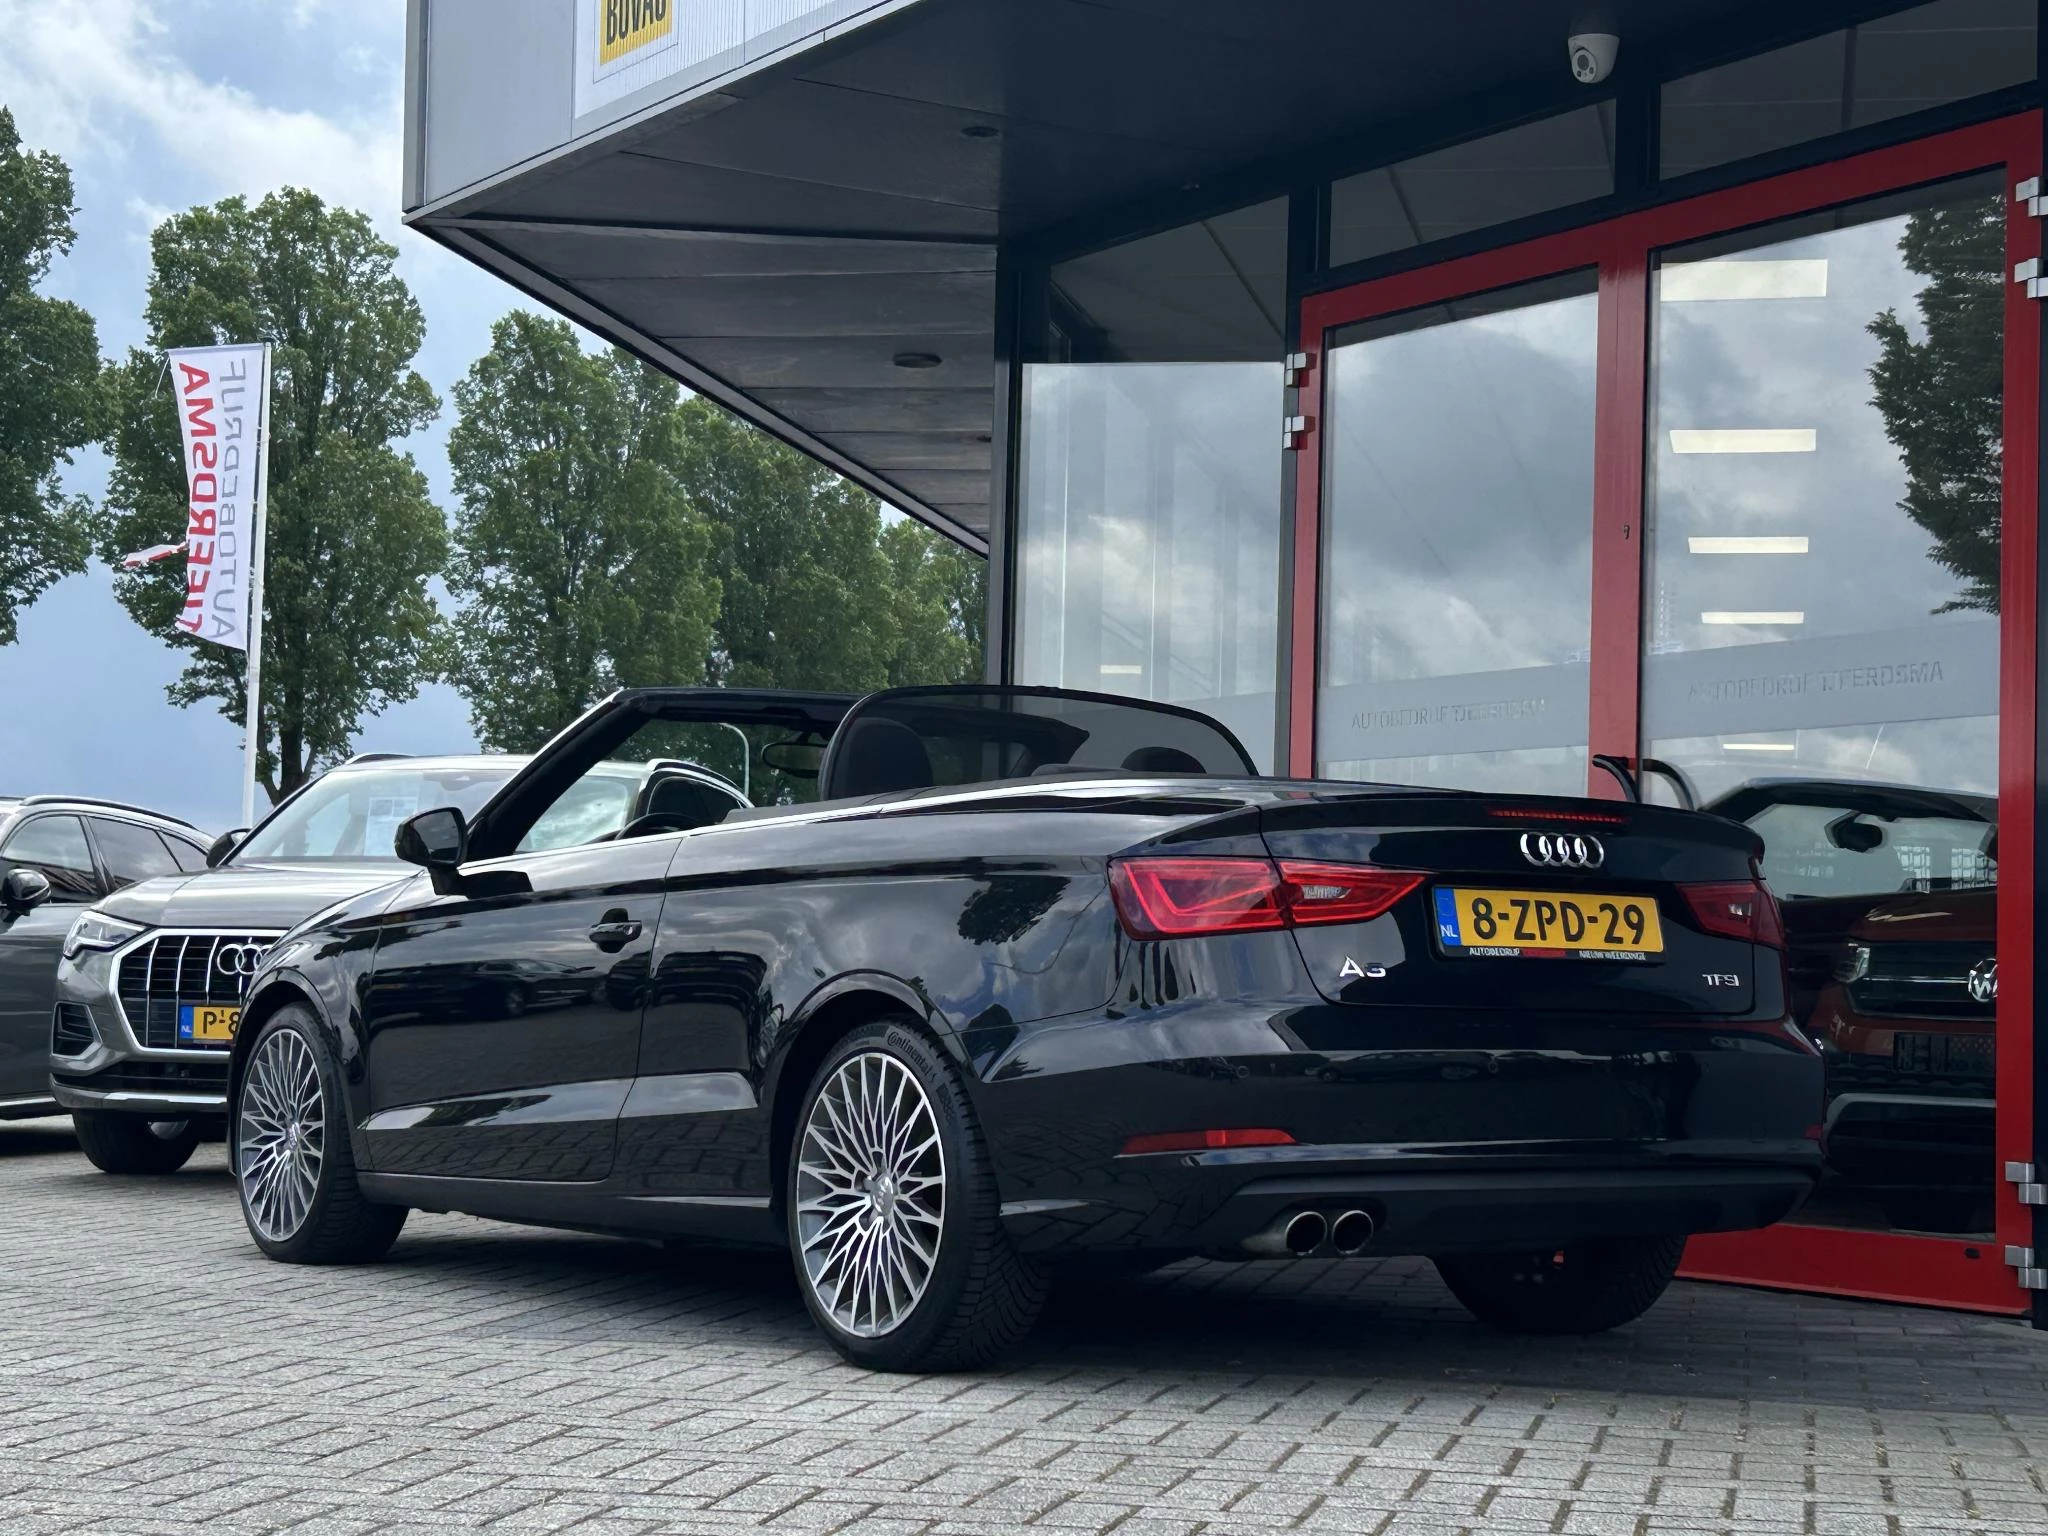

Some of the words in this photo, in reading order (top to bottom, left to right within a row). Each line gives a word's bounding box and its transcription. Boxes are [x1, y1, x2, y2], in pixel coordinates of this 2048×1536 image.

[1471, 897, 1645, 945] 8-ZPD-29
[1440, 924, 1458, 938] NL
[1702, 973, 1740, 987] TFSI
[180, 1024, 193, 1033] NL
[887, 1031, 934, 1077] Continental
